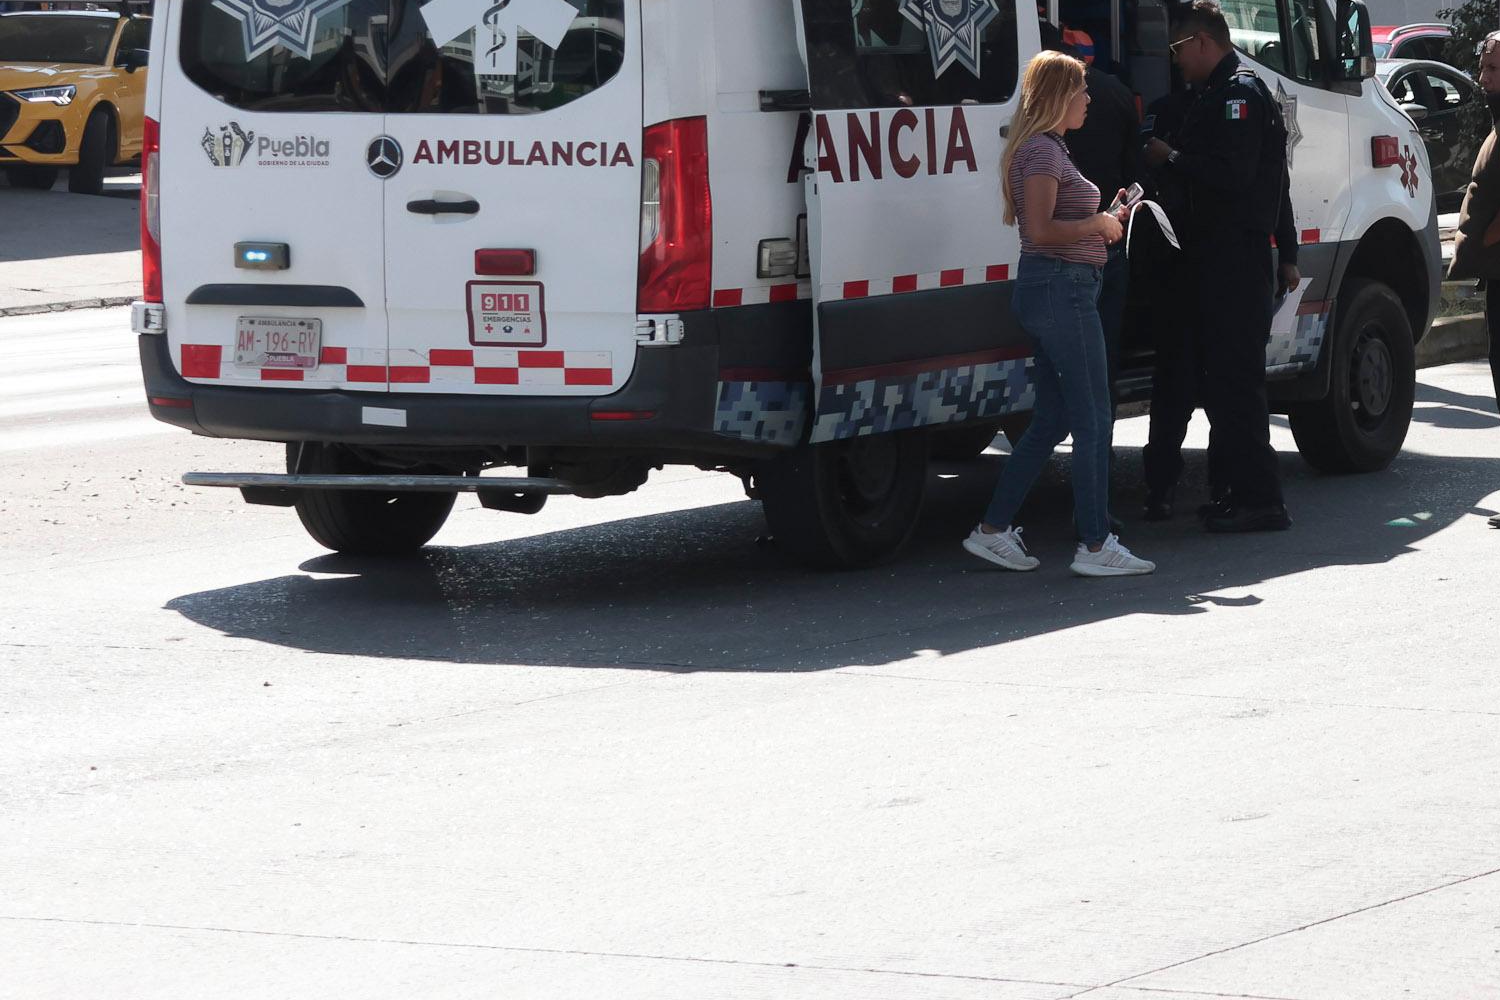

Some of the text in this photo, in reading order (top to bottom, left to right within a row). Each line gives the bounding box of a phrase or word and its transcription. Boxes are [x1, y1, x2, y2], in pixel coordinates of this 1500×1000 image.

[257, 135, 330, 158] Puebla
[412, 139, 634, 167] AMBULANCIA
[257, 319, 297, 327] AMBULANCIA
[482, 315, 532, 323] EMERGENCIAS
